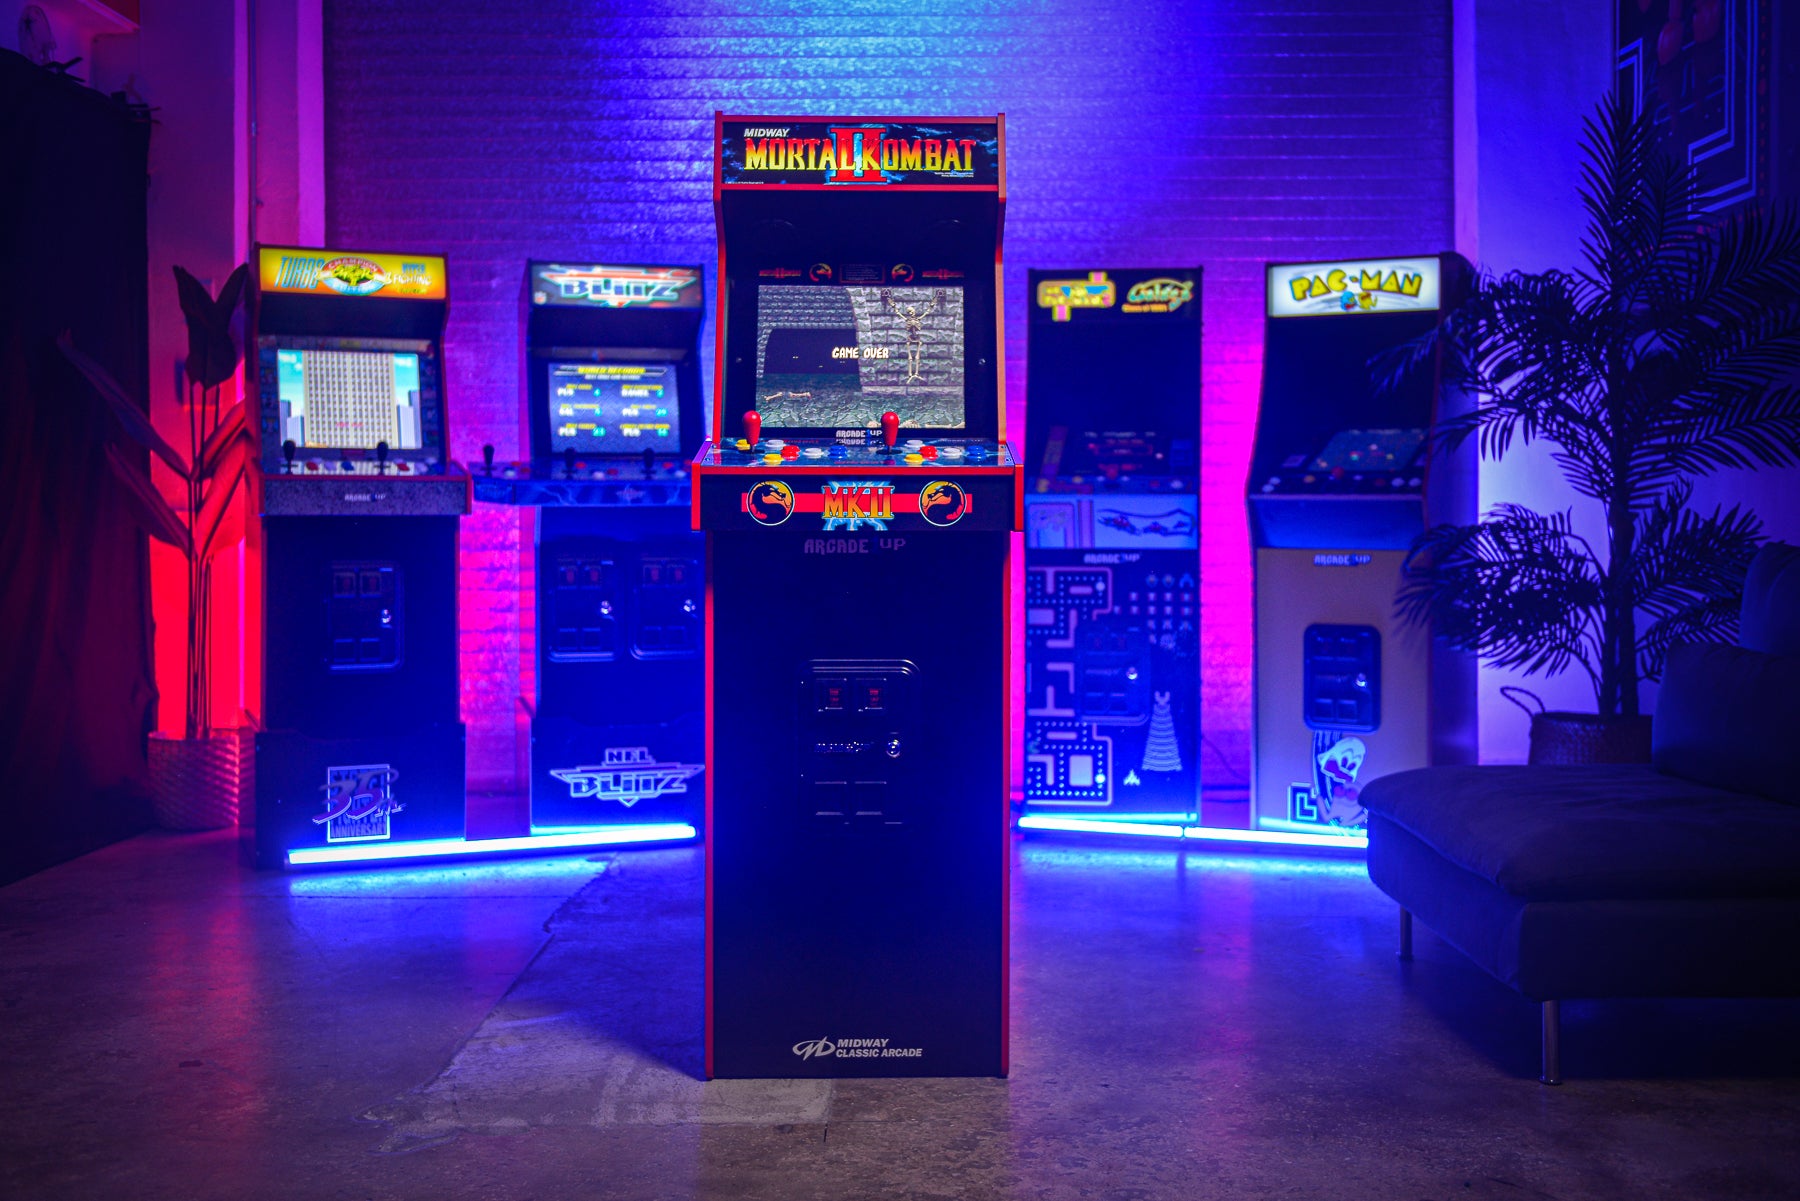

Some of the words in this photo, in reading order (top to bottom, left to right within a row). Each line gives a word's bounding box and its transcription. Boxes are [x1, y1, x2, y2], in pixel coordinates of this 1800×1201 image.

[744, 128, 789, 138] MIDWAY
[274, 256, 325, 290] TURBO
[560, 277, 679, 299] BLITZ
[1289, 269, 1423, 301] PAC-MAN
[832, 346, 859, 359] GAME
[863, 347, 889, 359] OVER
[836, 430, 866, 438] ARCADE
[803, 538, 870, 556] ARCADE
[606, 747, 650, 763] NFL
[570, 772, 687, 797] BLITZ
[331, 822, 387, 839] ANNIVERSARY
[837, 1038, 889, 1048] MIDWAY
[836, 1048, 880, 1058] CLASSIC
[881, 1048, 923, 1058] ARCADE
